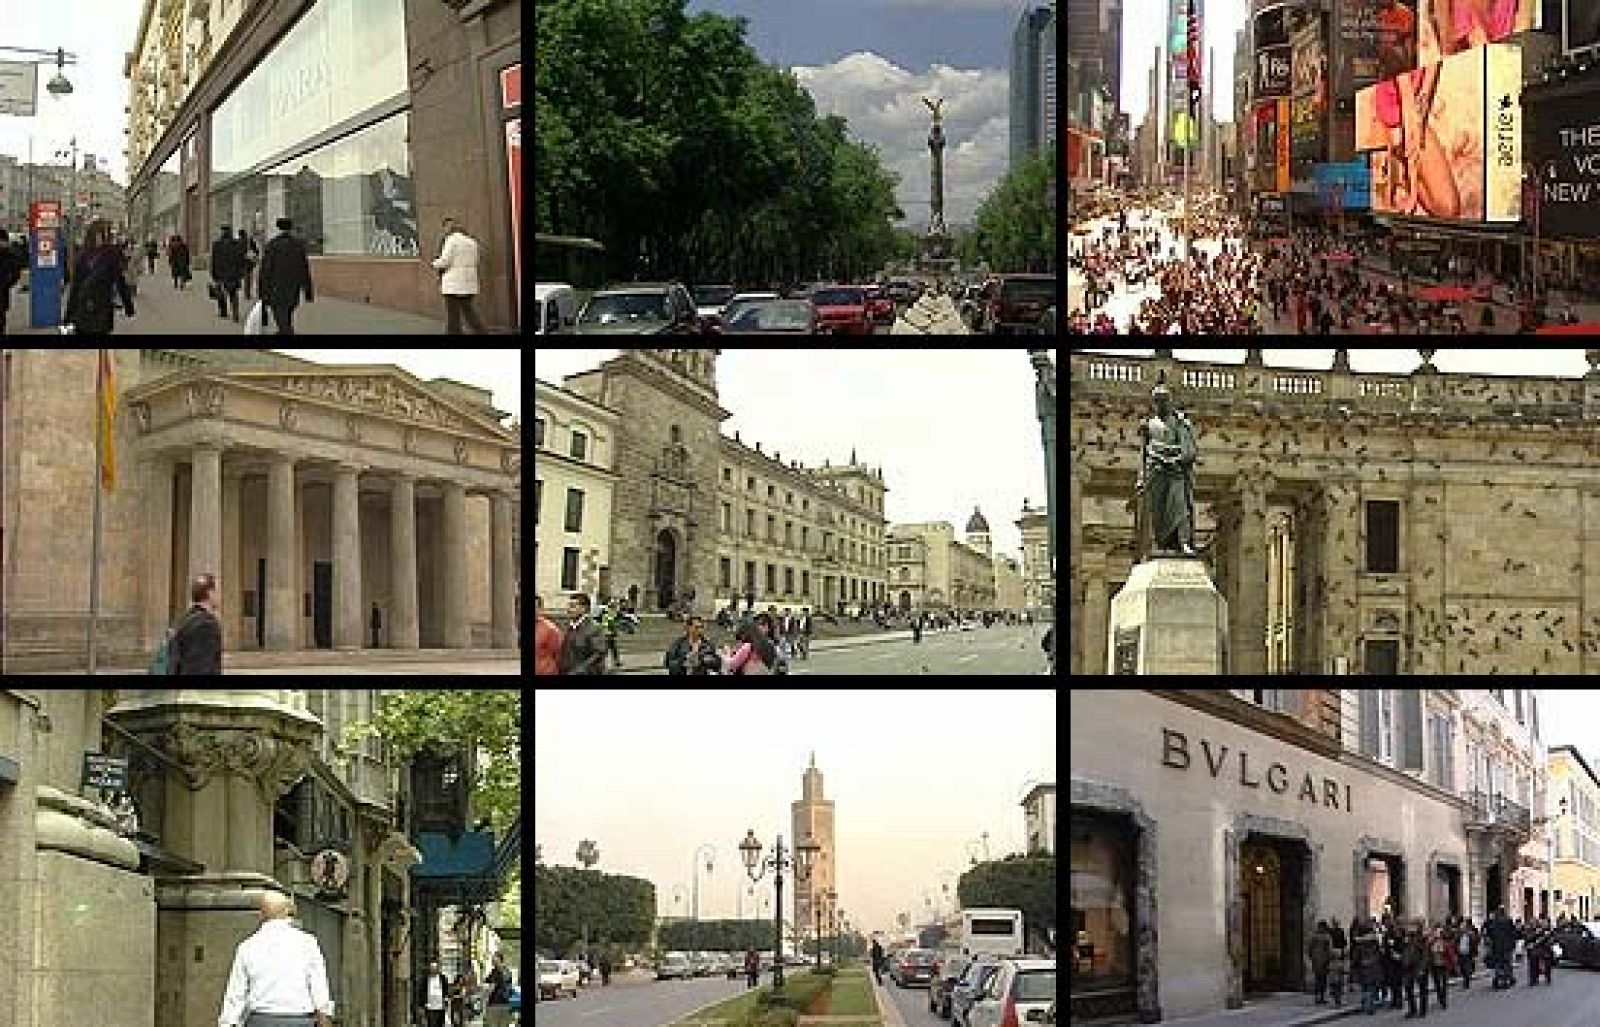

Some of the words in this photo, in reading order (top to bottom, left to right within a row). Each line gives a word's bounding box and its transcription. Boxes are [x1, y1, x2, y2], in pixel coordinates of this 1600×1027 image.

[1497, 113, 1513, 167] aerie
[1559, 124, 1600, 146] THE
[1544, 182, 1592, 202] NEW
[1161, 726, 1351, 813] BVLGARI
